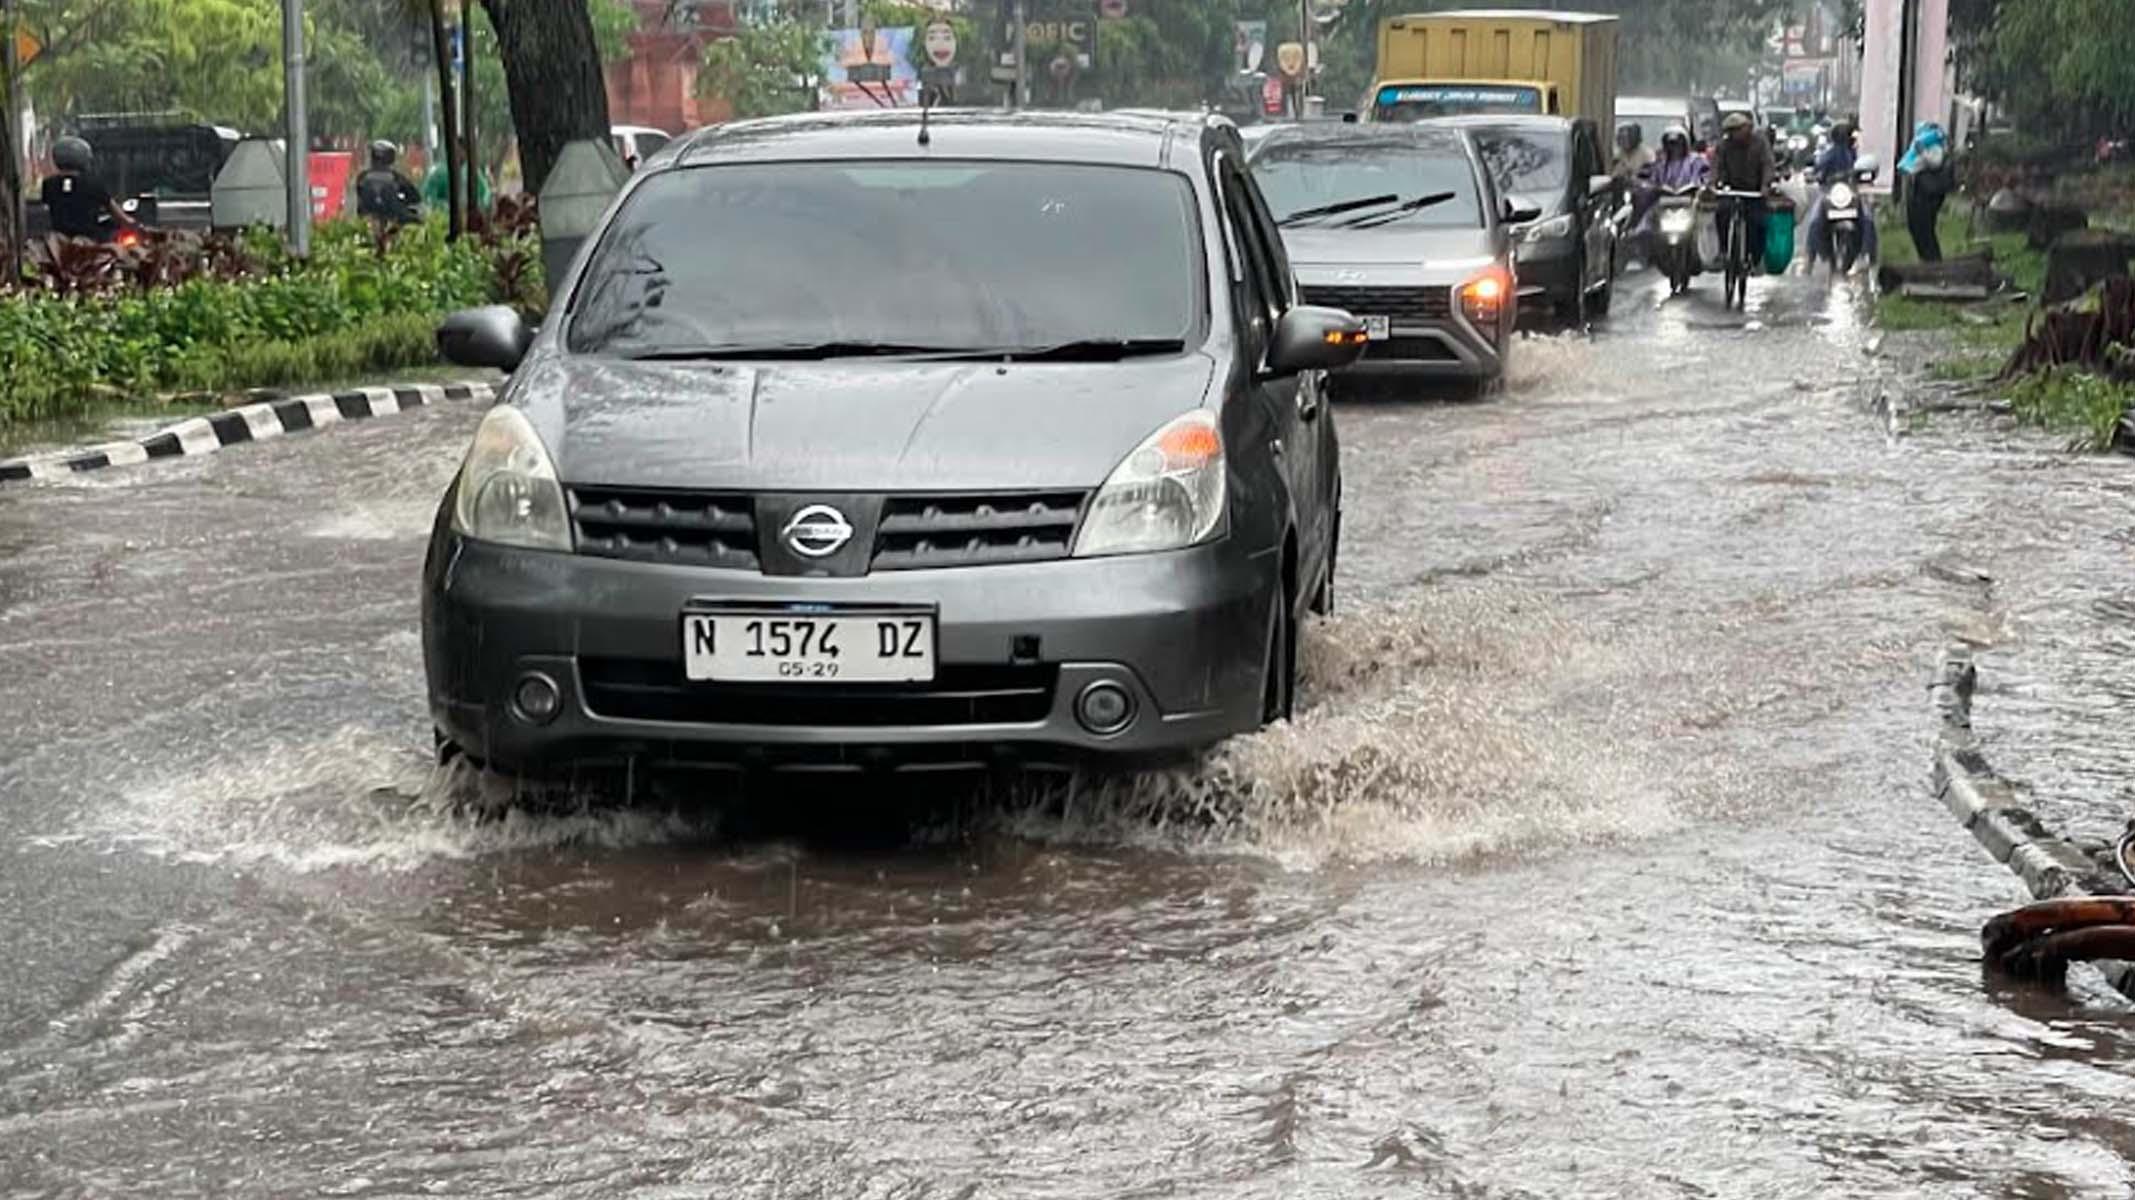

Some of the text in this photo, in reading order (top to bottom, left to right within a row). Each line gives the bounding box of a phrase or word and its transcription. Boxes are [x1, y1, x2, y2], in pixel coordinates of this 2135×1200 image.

[693, 619, 925, 659] N 1574 DZ
